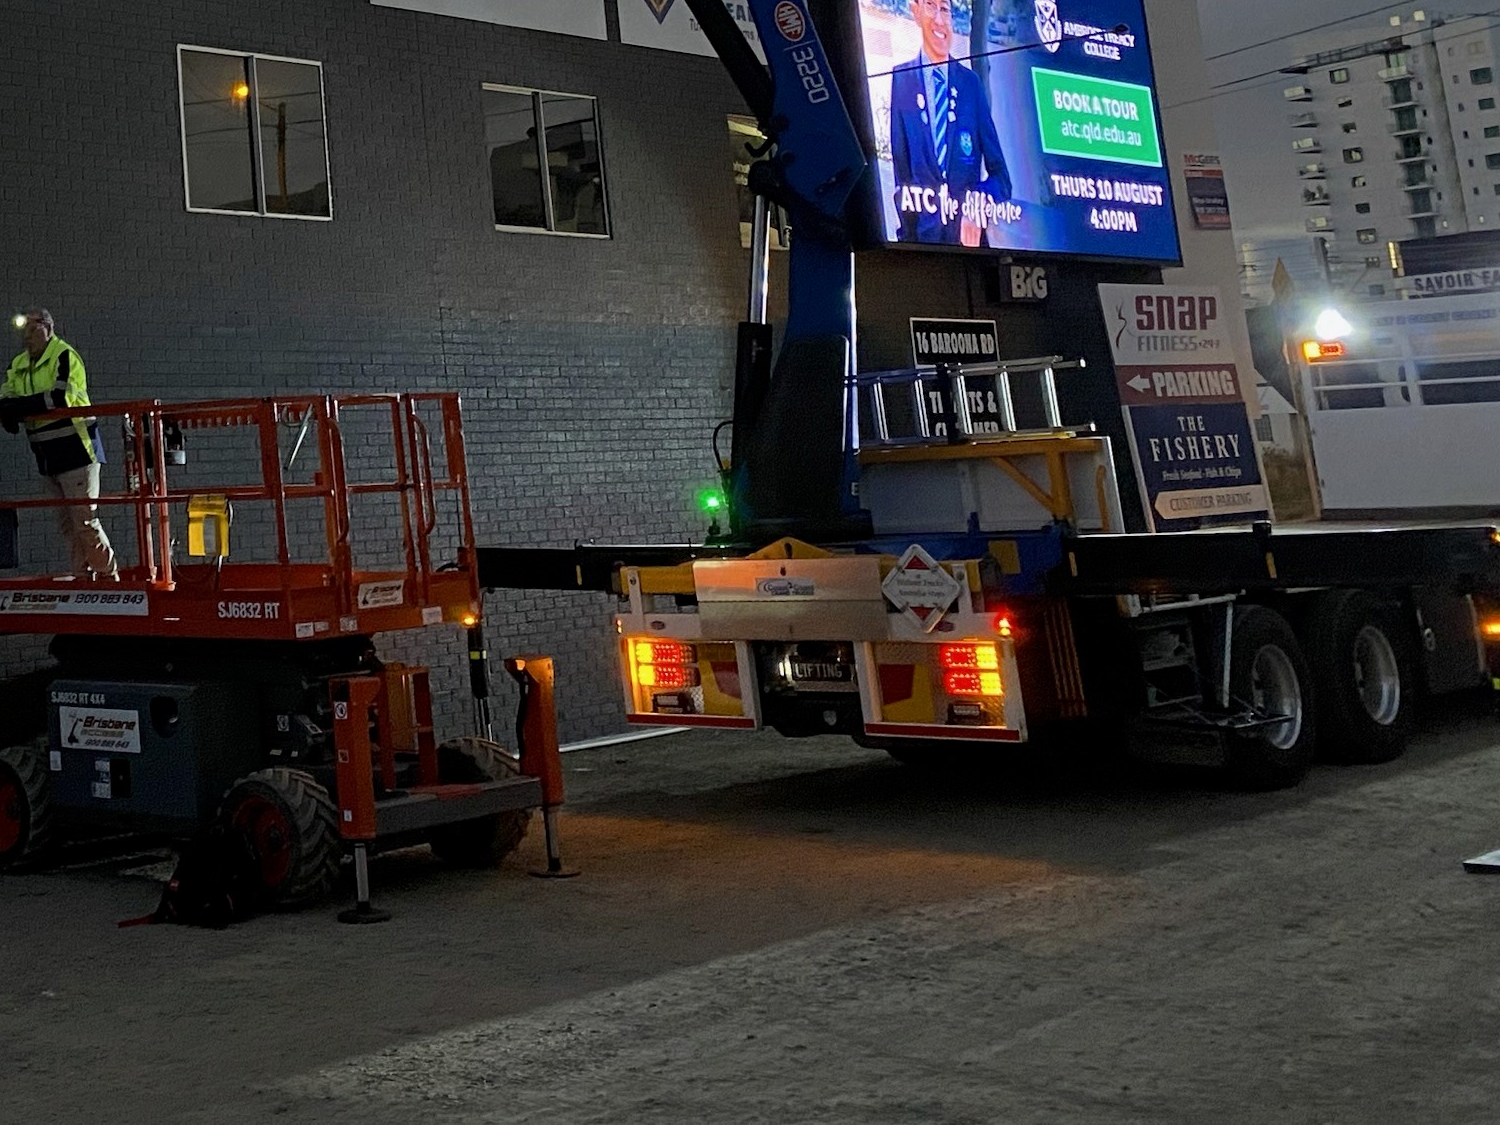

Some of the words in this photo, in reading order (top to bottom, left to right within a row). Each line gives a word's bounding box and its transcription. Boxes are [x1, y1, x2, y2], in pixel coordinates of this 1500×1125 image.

[776, 4, 802, 39] HMF
[1083, 41, 1121, 60] COLLEGE
[792, 46, 830, 104] 3220
[1052, 89, 1092, 114] BOOK
[1092, 95, 1104, 116] A
[1102, 97, 1139, 121] TOUR
[1061, 119, 1143, 147] atc.qld.edu.au
[1051, 174, 1097, 199] THURS
[1096, 179, 1113, 201] 10
[1114, 181, 1163, 206] AUGUST
[901, 185, 938, 214] ATC
[938, 183, 958, 225] the
[961, 190, 1022, 229] difference
[1090, 207, 1138, 233] 4:00PM
[1413, 272, 1475, 292] SAVOIR
[916, 332, 929, 354] 16
[930, 332, 979, 354] BAROONA
[980, 333, 995, 355] RD
[1137, 335, 1198, 352] FITNESS
[1152, 370, 1236, 397] PARKING
[1177, 415, 1206, 432] THE
[1149, 434, 1241, 462] FISHERY
[1170, 495, 1215, 511] CUSTOMER
[1215, 492, 1252, 506] PARKING
[12, 592, 70, 603] Brisbane
[74, 593, 98, 604] 1300
[122, 594, 145, 605] 843
[218, 602, 261, 618] SJ6832
[264, 602, 280, 619] RT
[794, 662, 843, 678] LIFTING
[79, 693, 89, 705] RT
[83, 716, 136, 730] Brisbane
